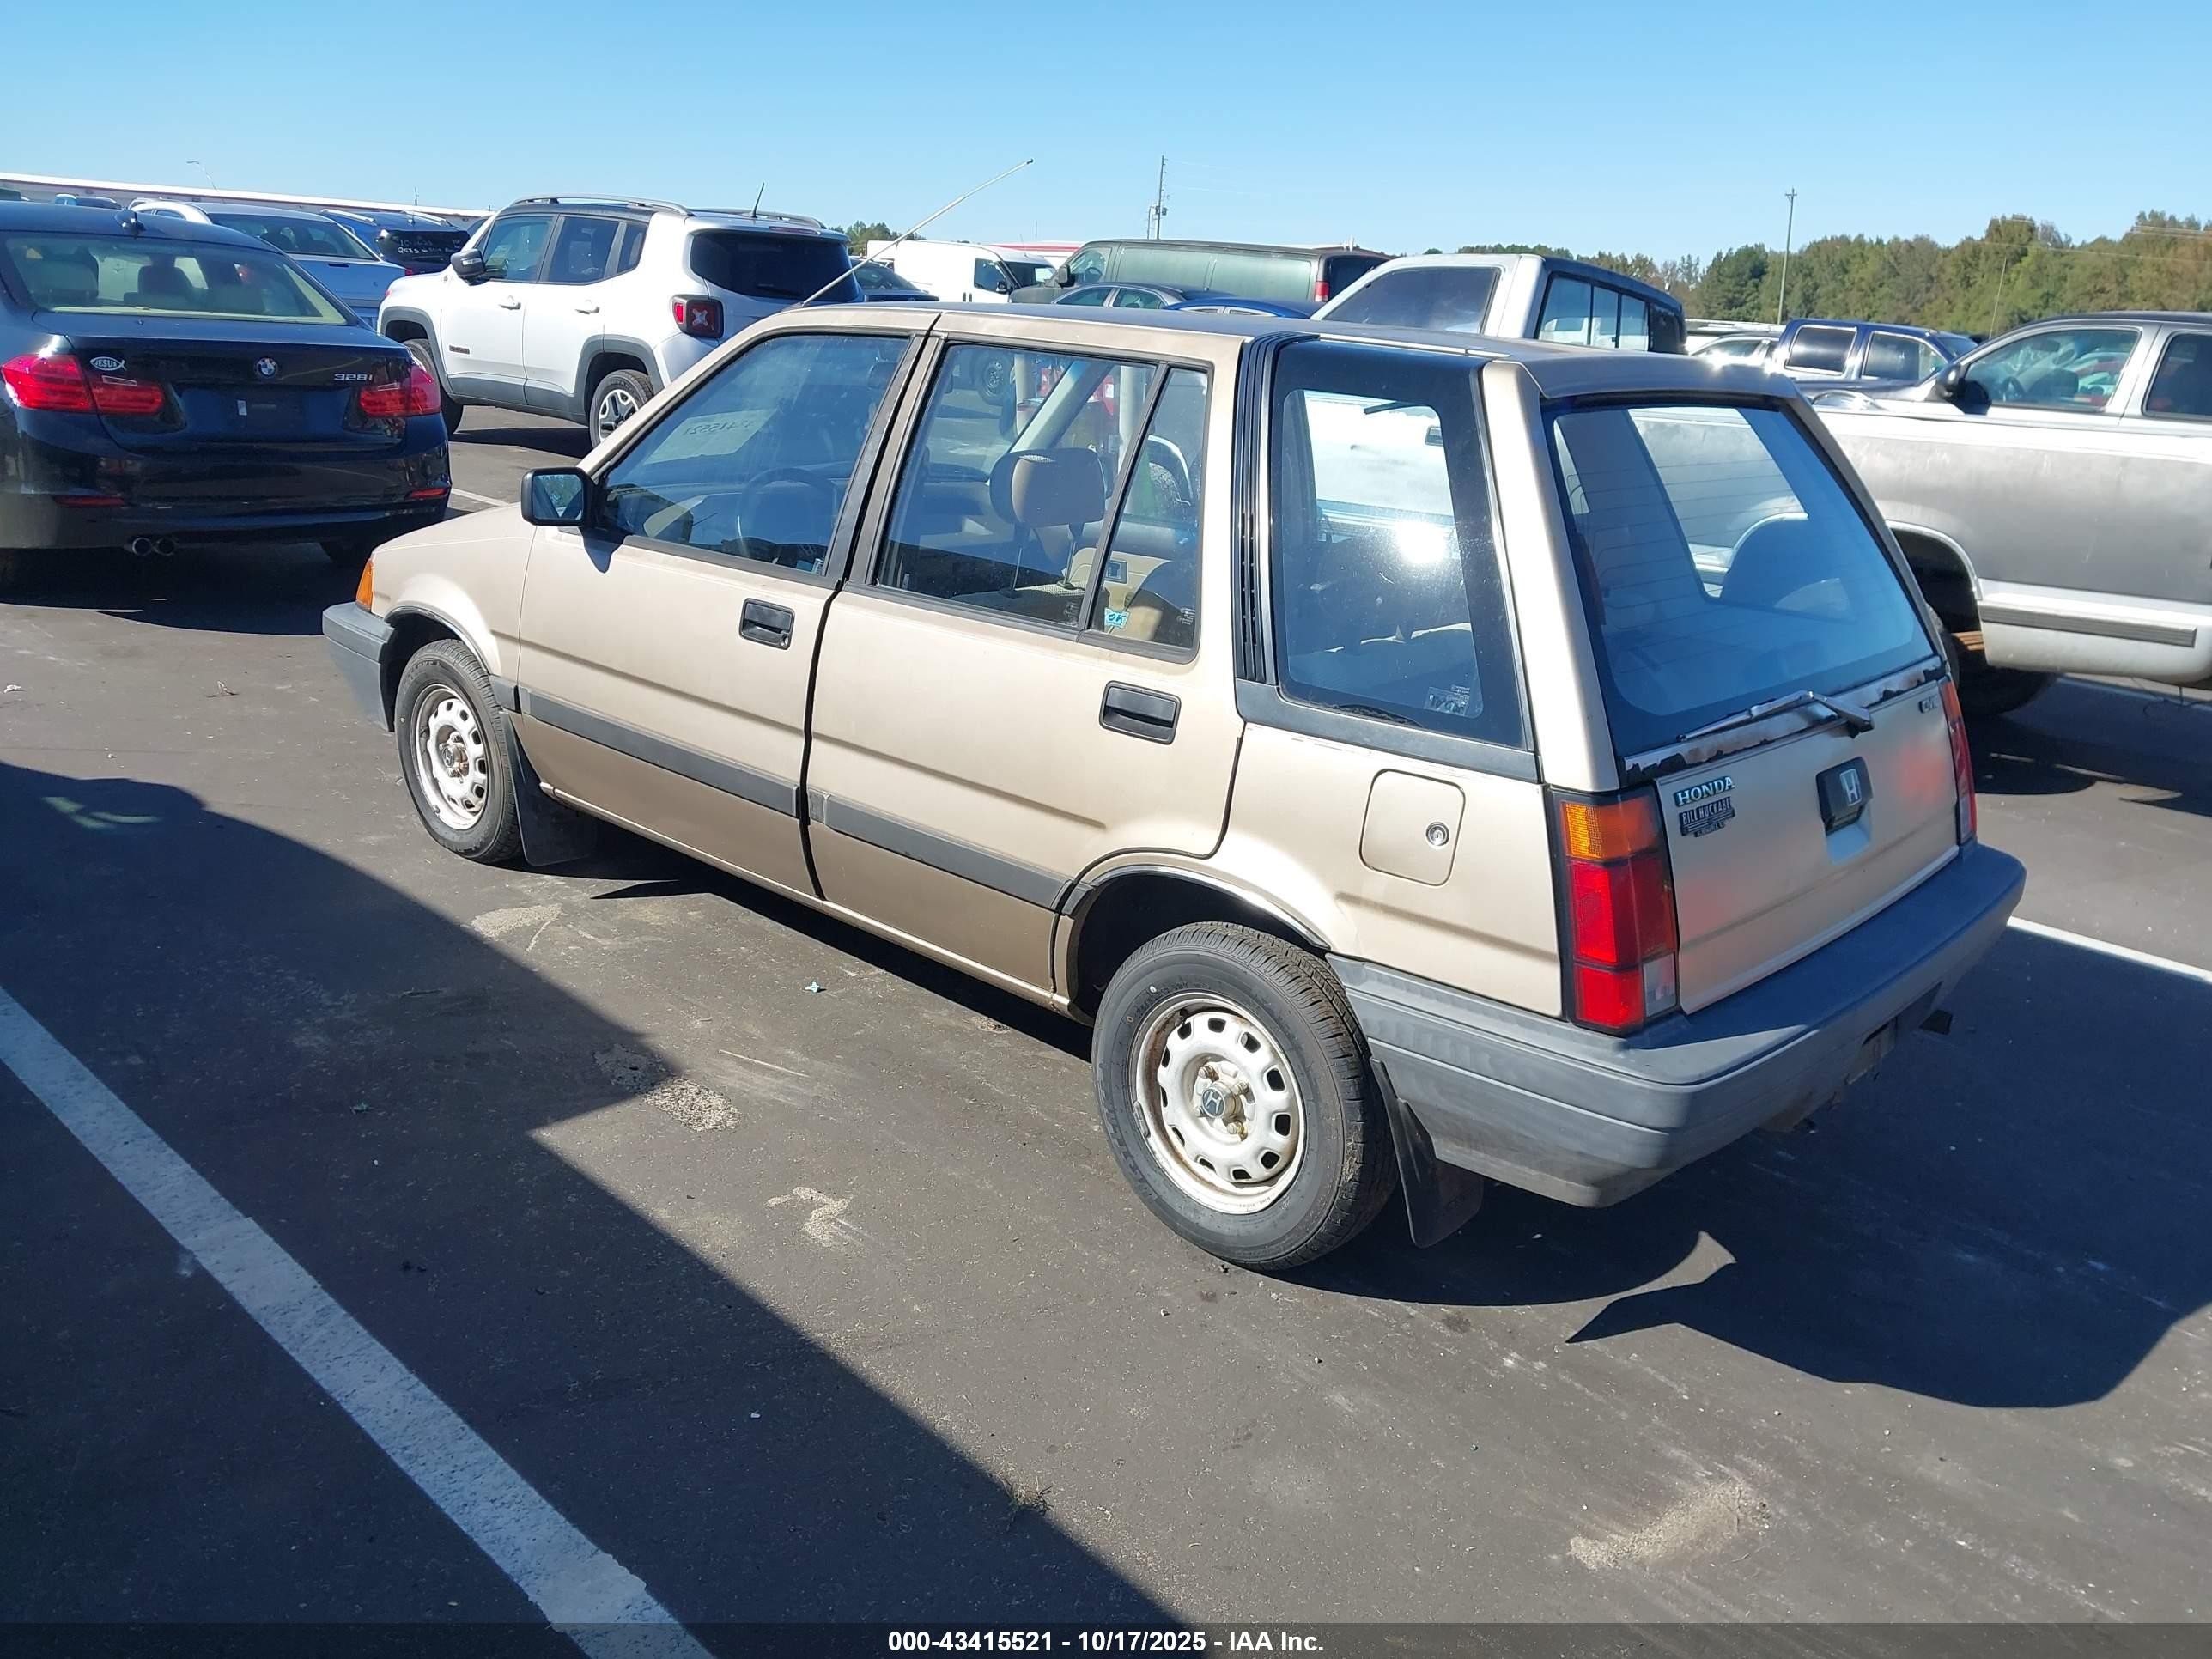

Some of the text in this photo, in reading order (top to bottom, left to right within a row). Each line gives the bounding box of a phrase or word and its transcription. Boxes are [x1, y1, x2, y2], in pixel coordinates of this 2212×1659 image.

[94, 359, 117, 368] JESUS
[1108, 613, 1126, 623] OK
[1676, 776, 1735, 805] HONDA
[1682, 809, 1698, 825] BILL
